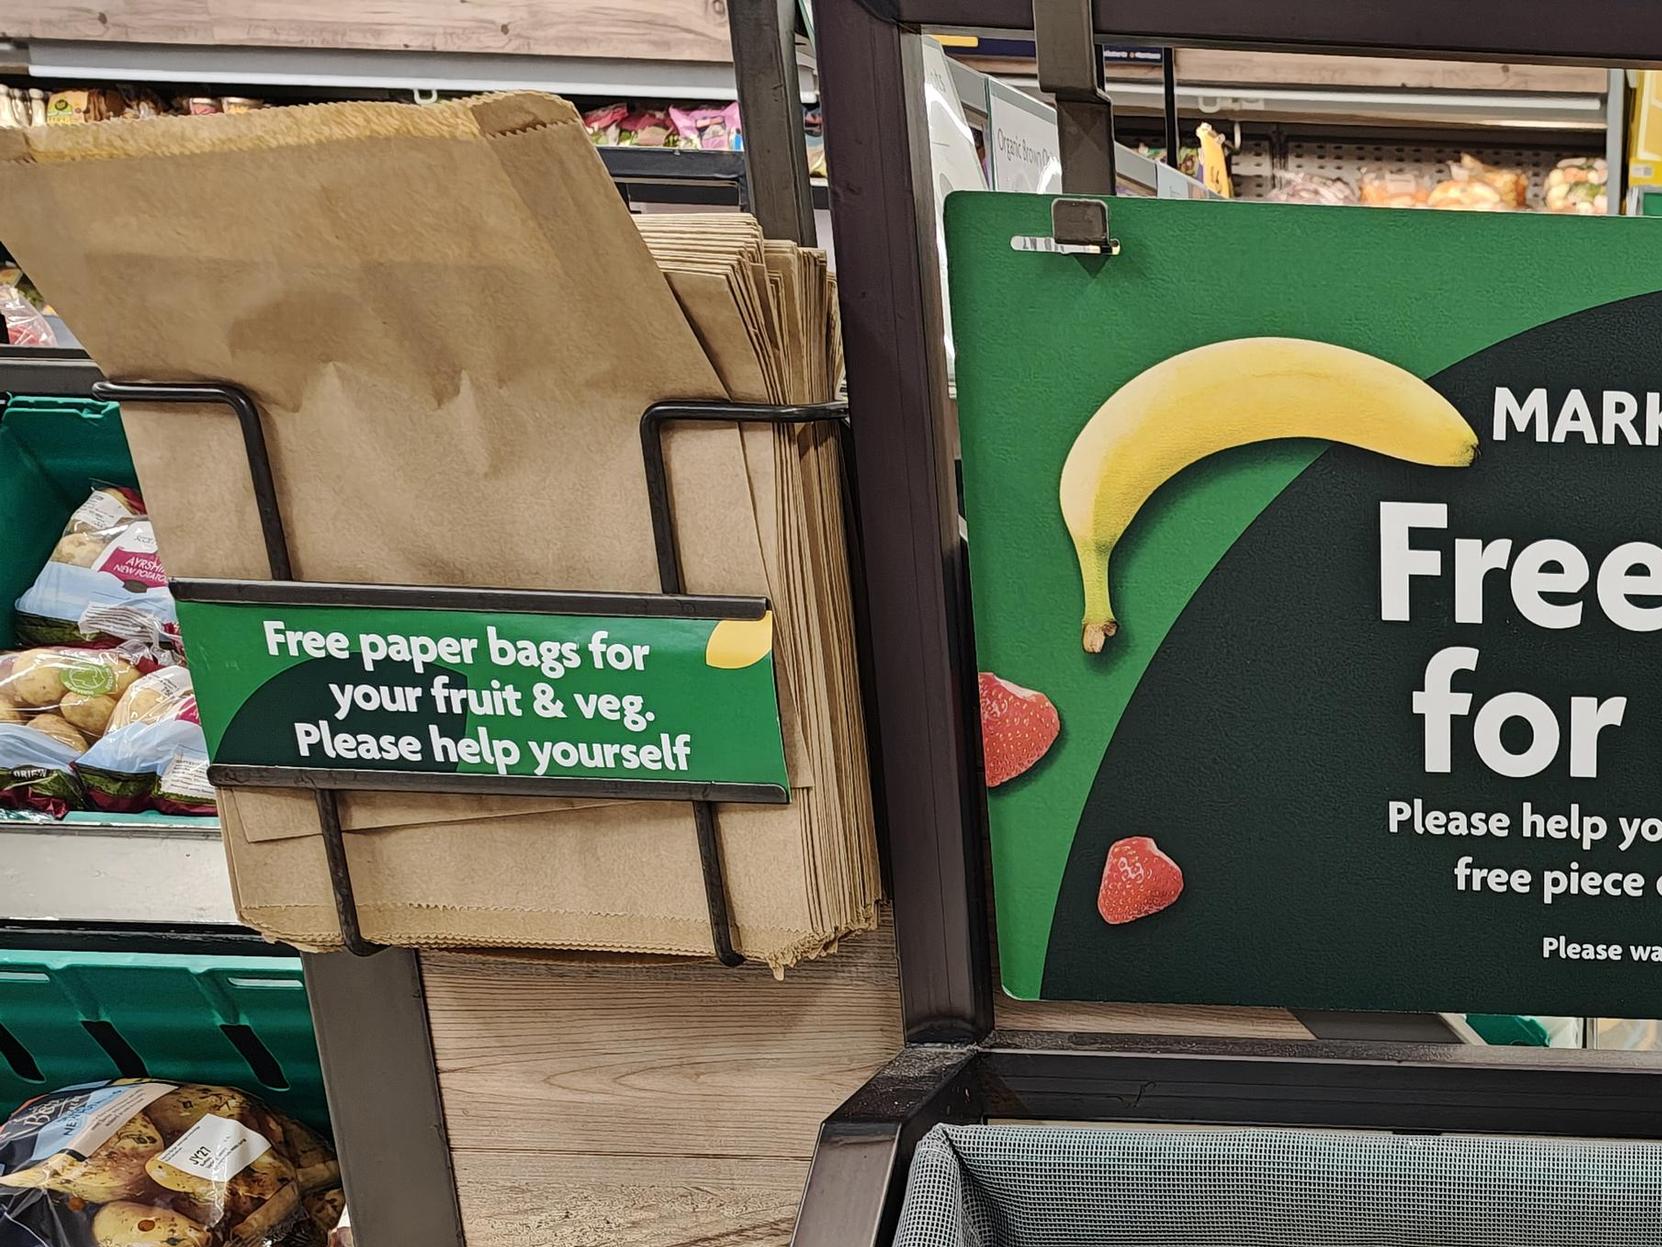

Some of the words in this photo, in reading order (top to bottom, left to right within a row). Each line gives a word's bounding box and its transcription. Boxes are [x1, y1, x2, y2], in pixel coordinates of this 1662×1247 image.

[264, 621, 349, 658] Free
[360, 634, 477, 678] paper
[487, 626, 580, 678] bags
[588, 631, 649, 670] for
[329, 684, 421, 720] your
[431, 676, 522, 716] fruit
[533, 683, 566, 717] &
[574, 694, 654, 731] veg.
[1413, 647, 1626, 777] for
[296, 722, 421, 763] Please
[432, 726, 520, 775] help
[534, 732, 690, 776] yourself
[1389, 799, 1510, 836] Please
[1523, 803, 1607, 849] help
[1455, 857, 1531, 892] free
[1544, 862, 1644, 903] piece
[1544, 936, 1622, 960] Please
